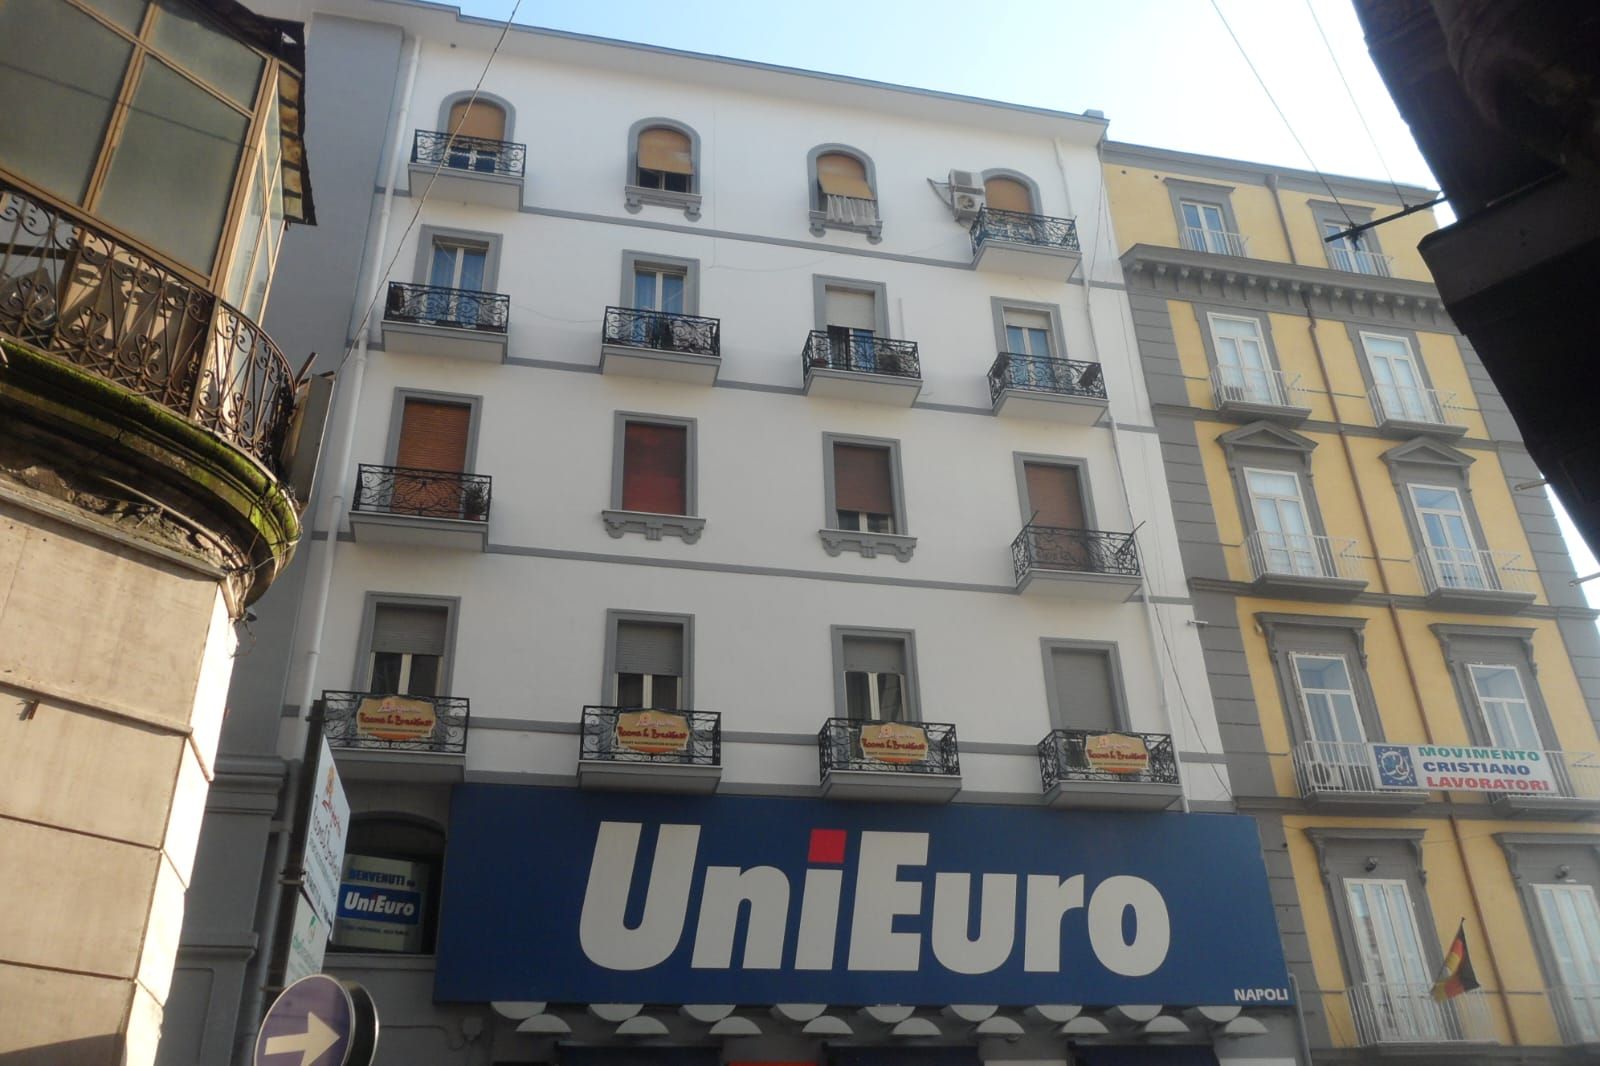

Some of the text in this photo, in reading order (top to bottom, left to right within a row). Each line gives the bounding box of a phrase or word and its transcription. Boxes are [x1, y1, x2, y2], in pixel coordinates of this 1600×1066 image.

[1418, 746, 1540, 762] MOVIMENTO
[1423, 761, 1530, 775] CRISTIANO
[1427, 776, 1549, 791] LAVORATORI
[349, 869, 405, 886] BENVENUTI
[344, 891, 415, 916] UniEuro
[579, 821, 1171, 977] UniEuro
[1233, 988, 1289, 1001] NAPOLI
